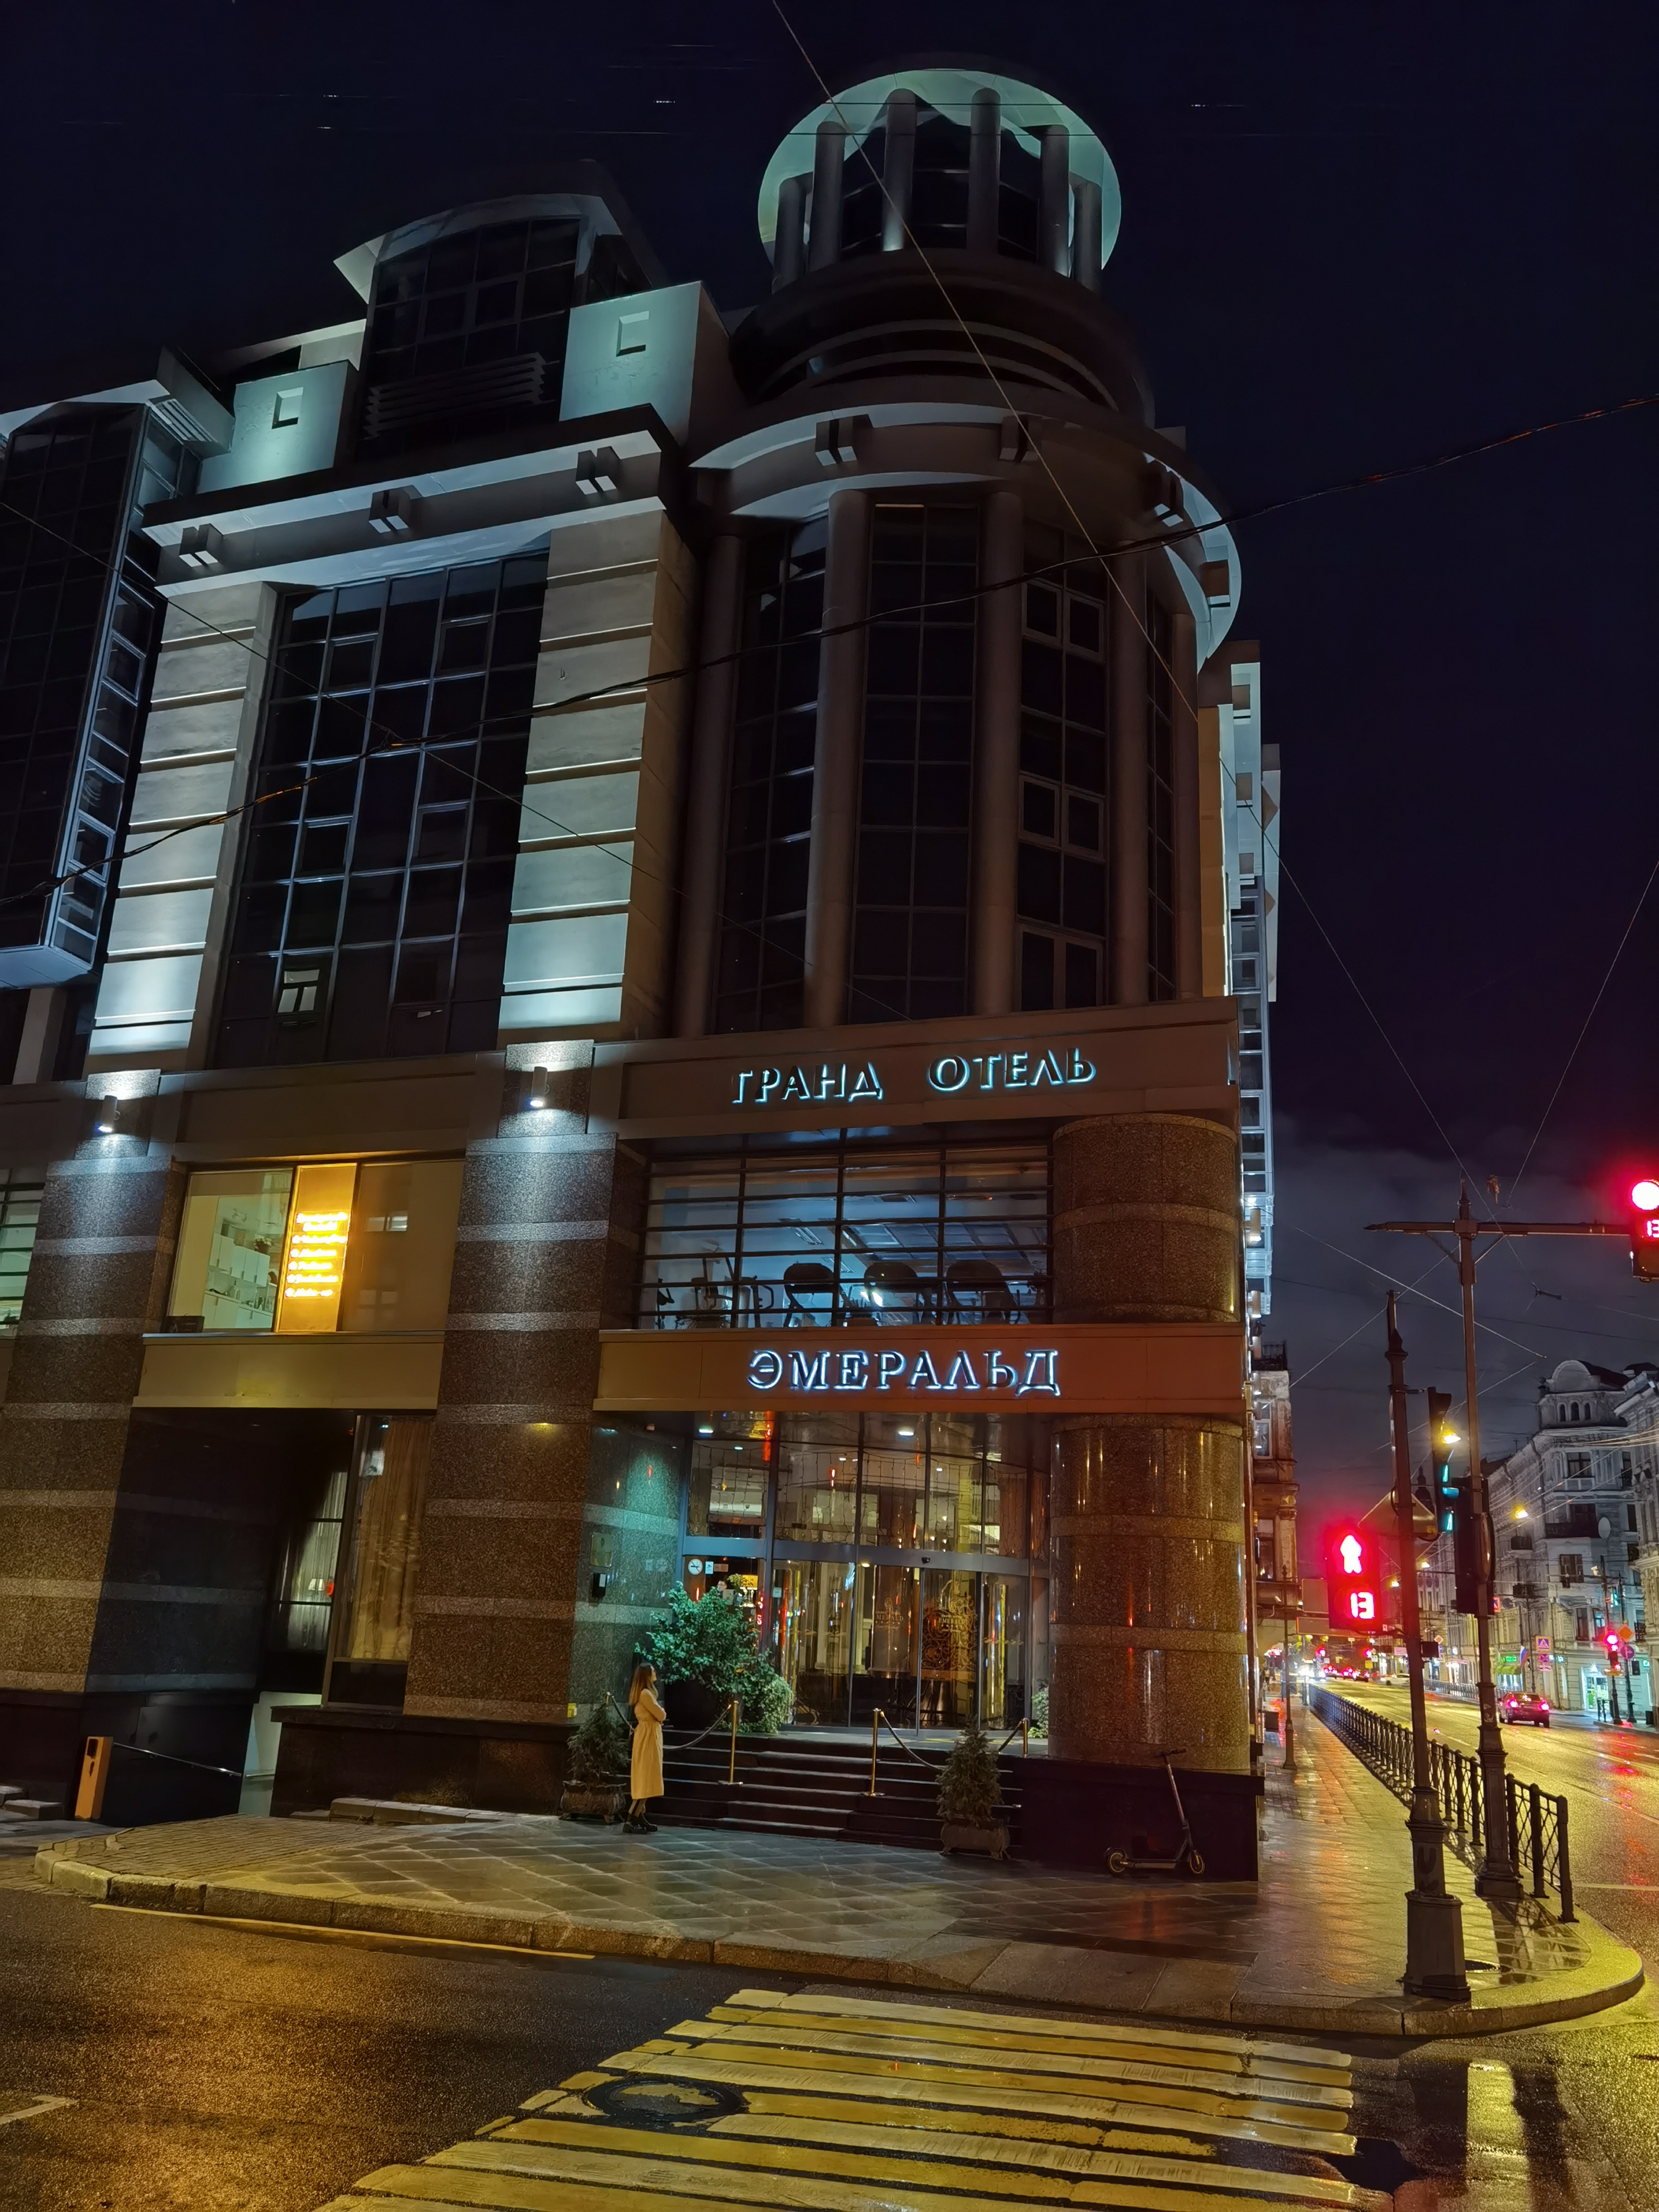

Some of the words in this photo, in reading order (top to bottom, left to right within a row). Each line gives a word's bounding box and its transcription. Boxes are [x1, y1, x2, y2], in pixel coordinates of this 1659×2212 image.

[732, 1061, 884, 1103] ГРАНД
[926, 1048, 1097, 1091] ОТЕЛЬ
[747, 1350, 1061, 1397] ЭМЕРАЛЬД
[1350, 1591, 1374, 1620] 13
